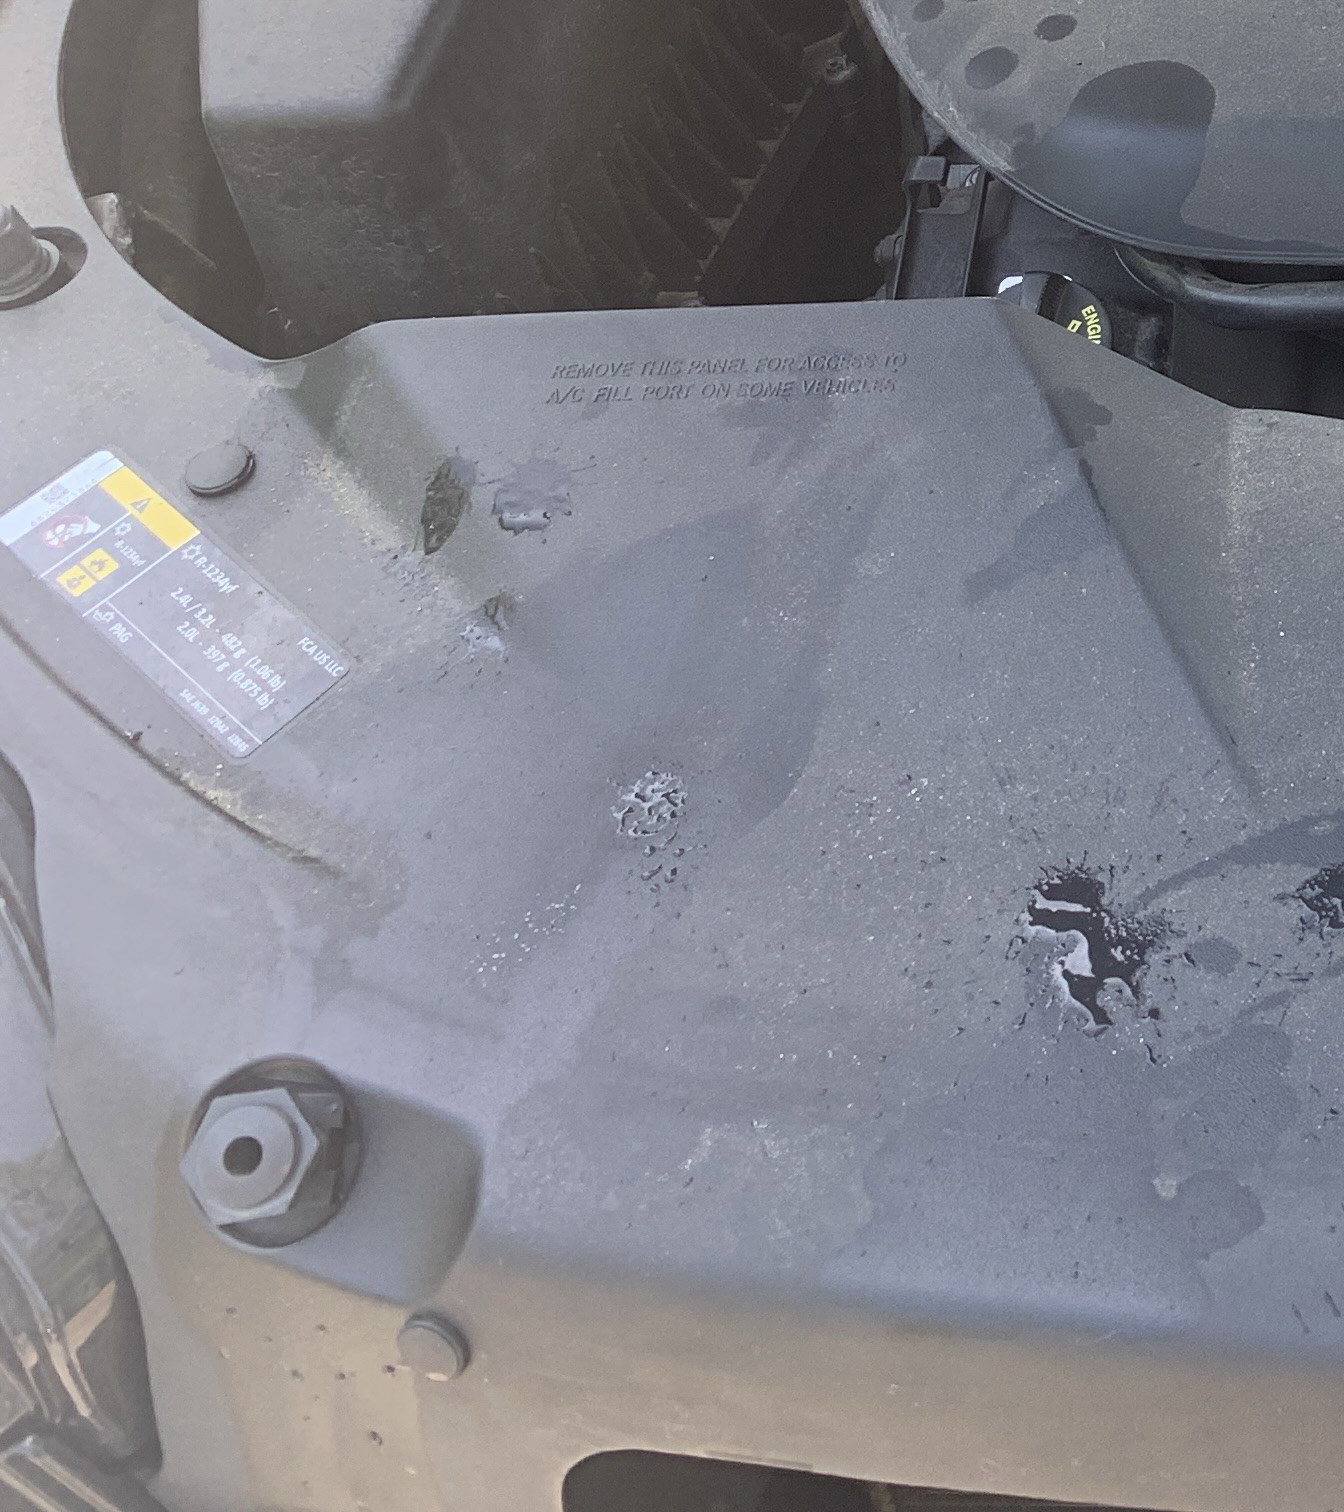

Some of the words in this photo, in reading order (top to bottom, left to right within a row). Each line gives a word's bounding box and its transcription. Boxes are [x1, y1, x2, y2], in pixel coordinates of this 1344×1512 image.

[550, 361, 635, 379] REMOVE
[641, 360, 683, 376] THIS
[689, 357, 747, 374] PANEL
[755, 357, 794, 372] FOR
[799, 353, 877, 371] ACCESS
[546, 386, 585, 404] A/C
[593, 386, 633, 403] FILL
[642, 384, 695, 401] PORT
[701, 383, 731, 399] ON
[738, 381, 795, 397] SOME
[194, 559, 240, 594] R-1234yf
[194, 608, 216, 628] 3.2L
[108, 623, 133, 643] PAG
[177, 621, 199, 642] 2.0L
[203, 645, 226, 663] 397
[227, 669, 262, 697] (0.875
[297, 637, 318, 656] FCA
[313, 650, 330, 665] US
[324, 658, 345, 677] LLC
